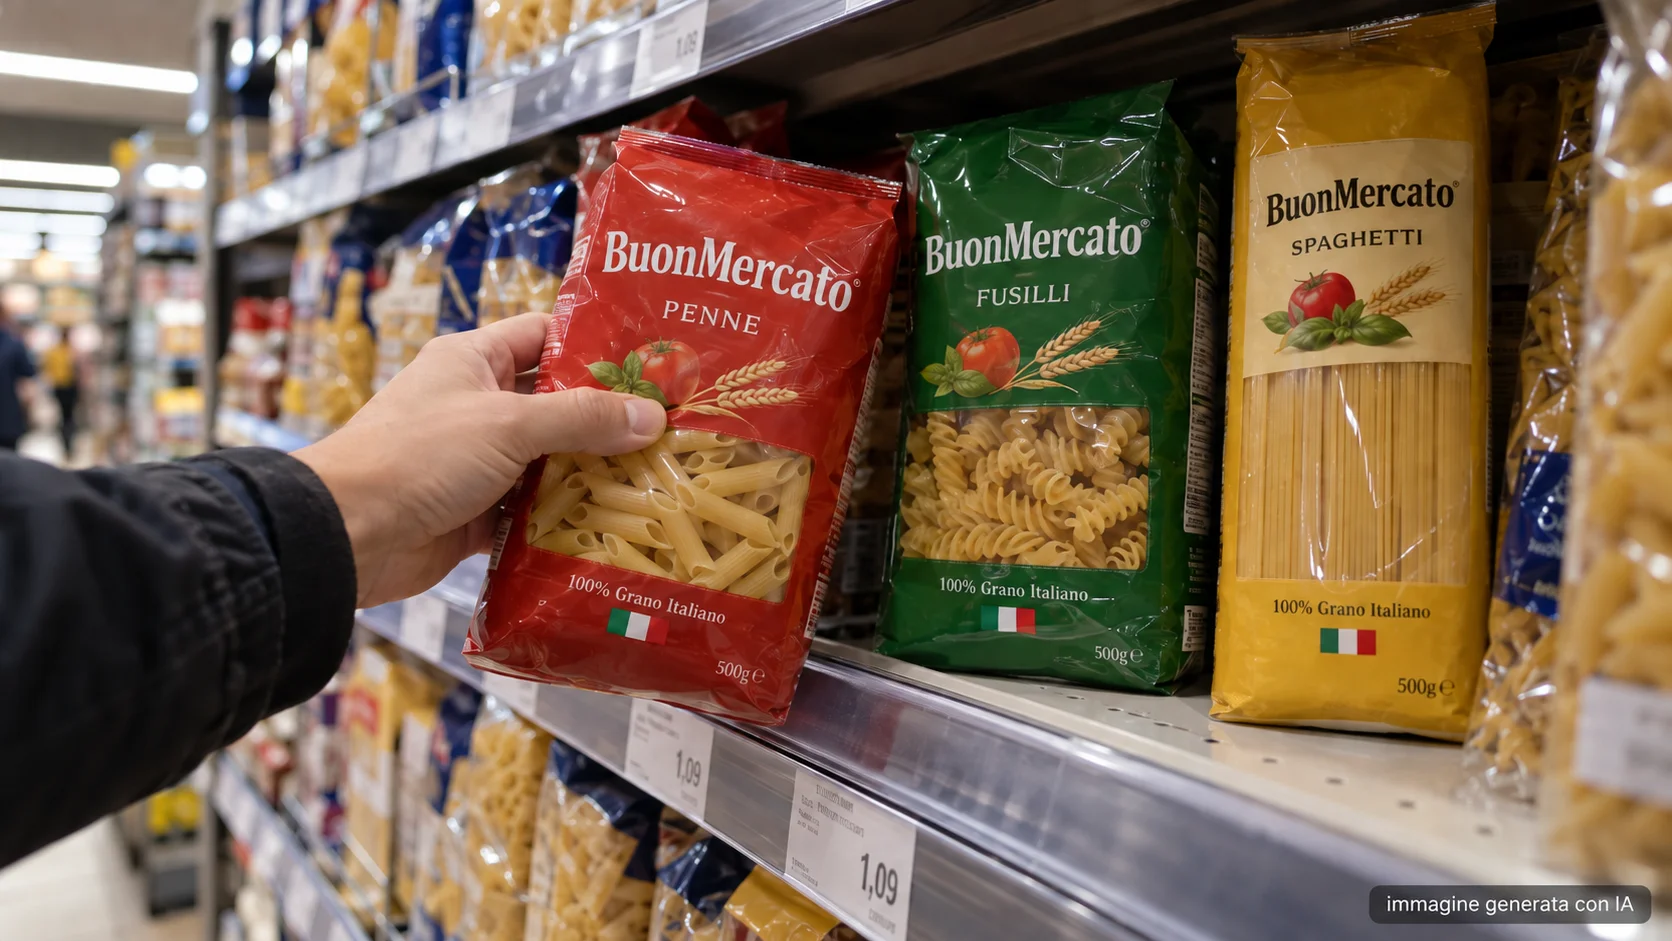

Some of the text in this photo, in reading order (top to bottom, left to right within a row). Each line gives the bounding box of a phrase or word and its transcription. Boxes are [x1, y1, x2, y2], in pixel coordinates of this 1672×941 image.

[1291, 229, 1423, 256] SPAGHETTI
[976, 283, 1071, 308] FUSILLI
[661, 300, 761, 336] PENNE
[568, 573, 727, 625] 100% Grano Italiano
[939, 576, 1089, 602] 100% Grano Italiano
[1273, 598, 1431, 620] 100% Grano Italiano
[676, 748, 702, 787] 1,09
[860, 852, 899, 906] 1,09
